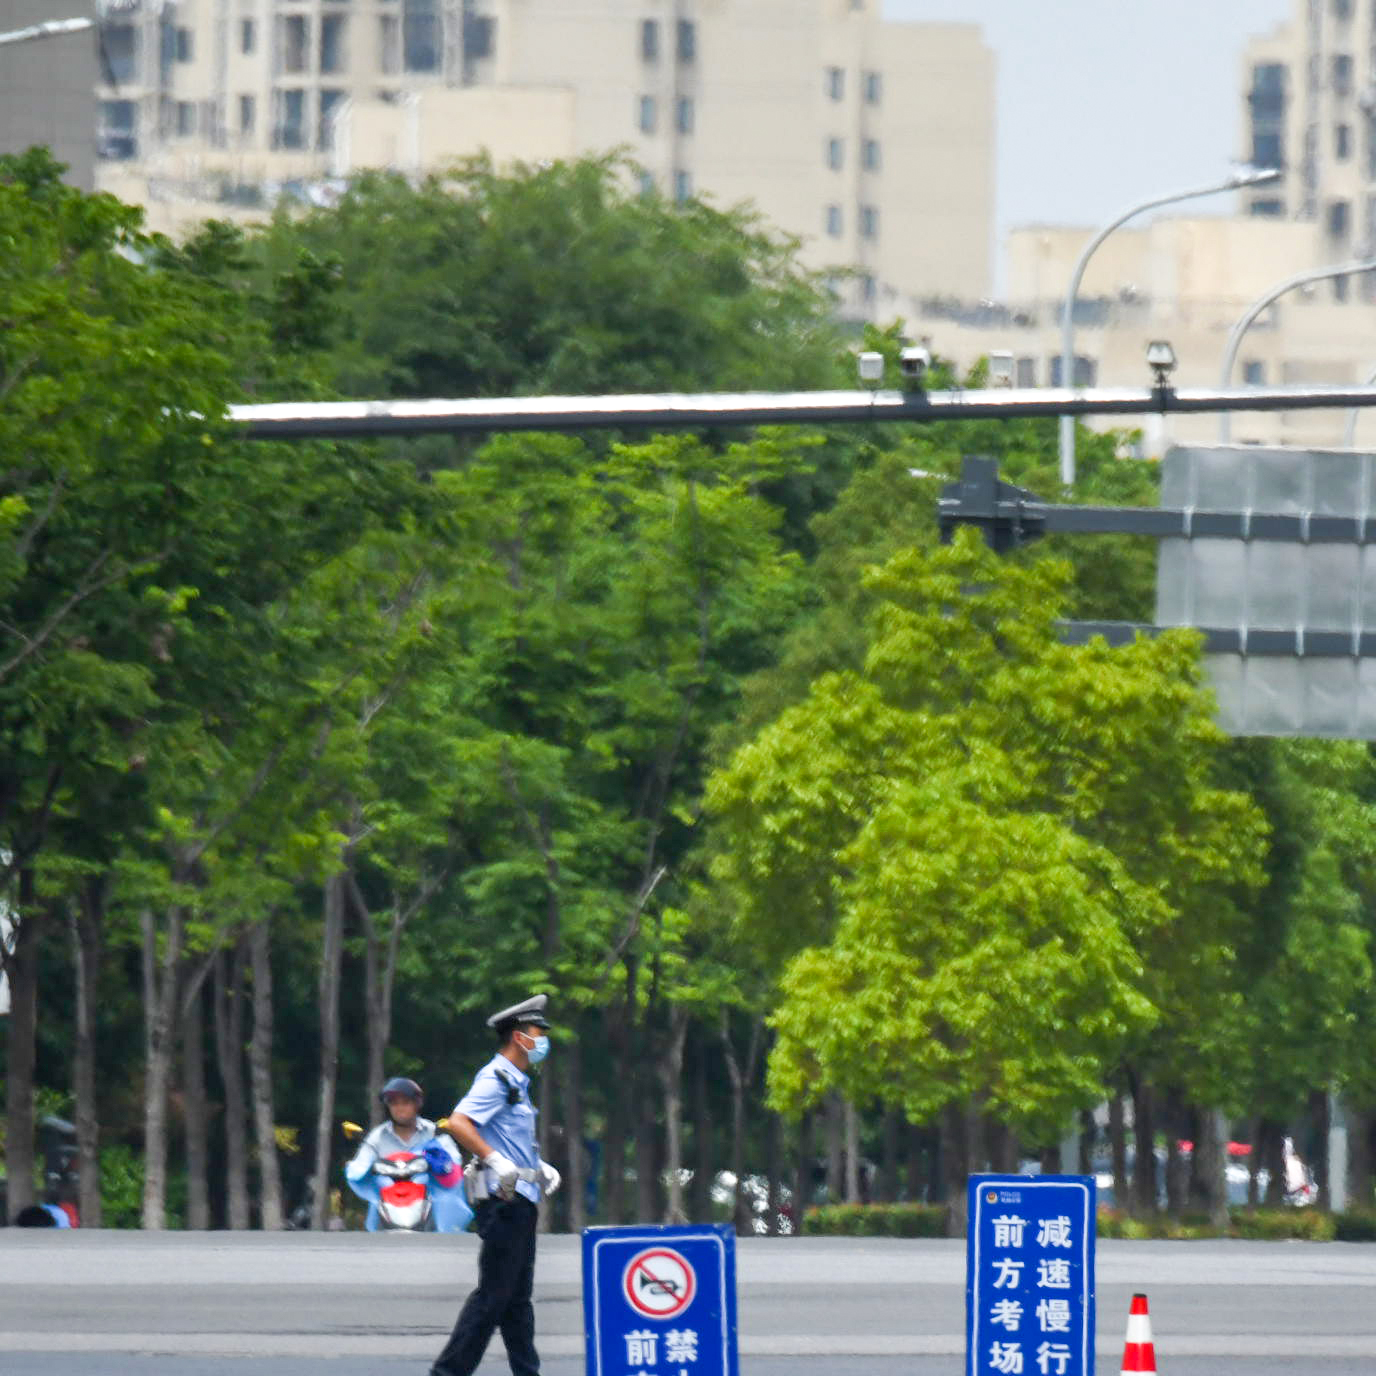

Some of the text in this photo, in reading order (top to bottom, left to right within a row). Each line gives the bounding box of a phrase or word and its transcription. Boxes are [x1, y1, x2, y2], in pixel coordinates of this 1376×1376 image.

[988, 1215, 1026, 1374] 前方考场
[1035, 1216, 1073, 1375] 减速慢行
